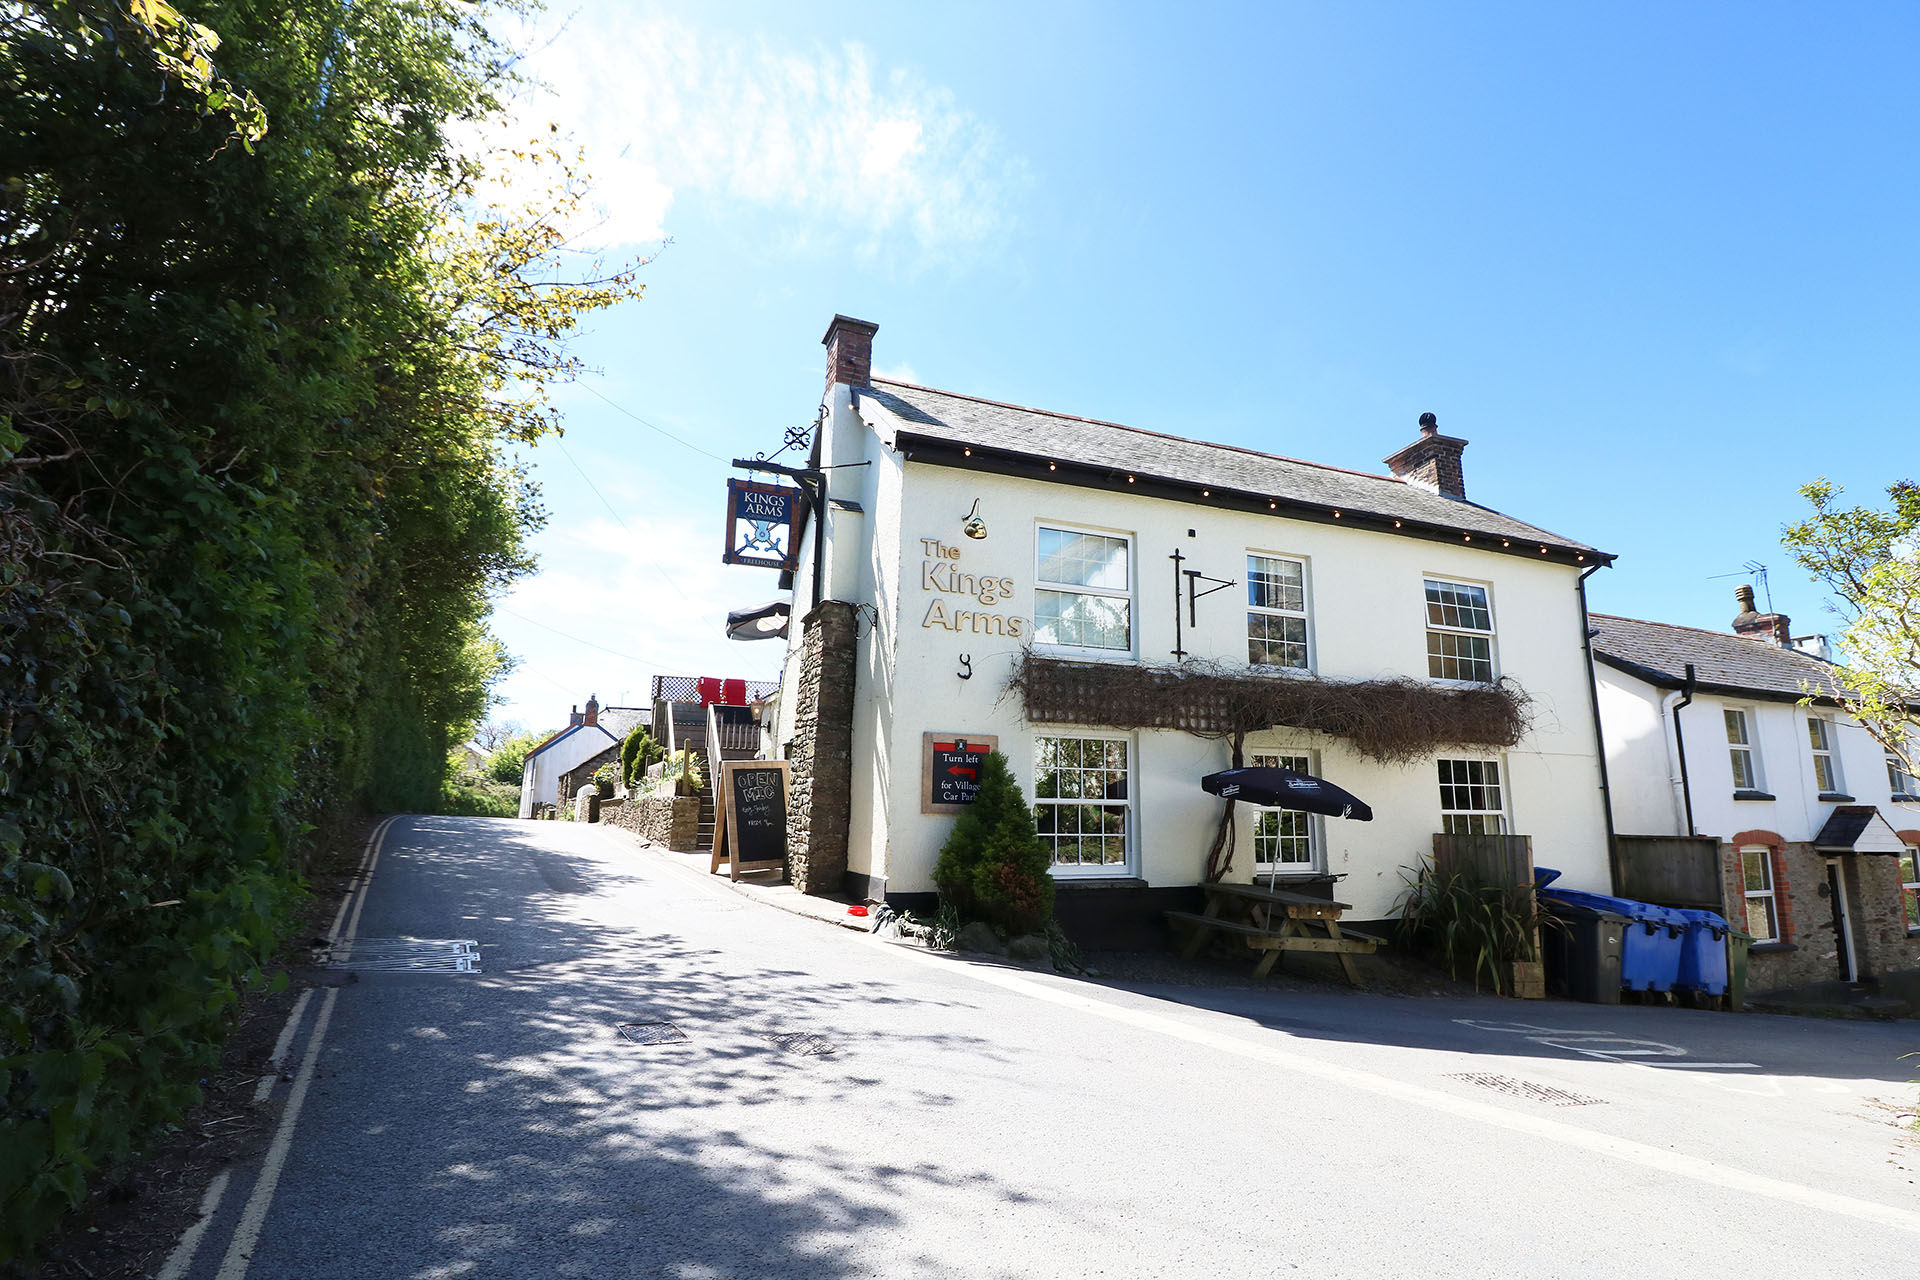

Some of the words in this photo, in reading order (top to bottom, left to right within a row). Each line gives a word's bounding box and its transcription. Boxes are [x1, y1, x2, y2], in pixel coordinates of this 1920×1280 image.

[744, 492, 785, 507] KINGS
[745, 503, 783, 517] ARMS
[920, 538, 960, 560] The
[743, 558, 779, 567] FREEHOUSE
[922, 560, 1015, 606] Kings
[922, 598, 1023, 637] Arms
[943, 753, 963, 763] Turn
[965, 754, 979, 763] left
[737, 772, 779, 788] OPEN
[941, 780, 952, 789] for
[955, 781, 981, 791] Village
[743, 786, 775, 802] MIC
[943, 791, 958, 800] Car
